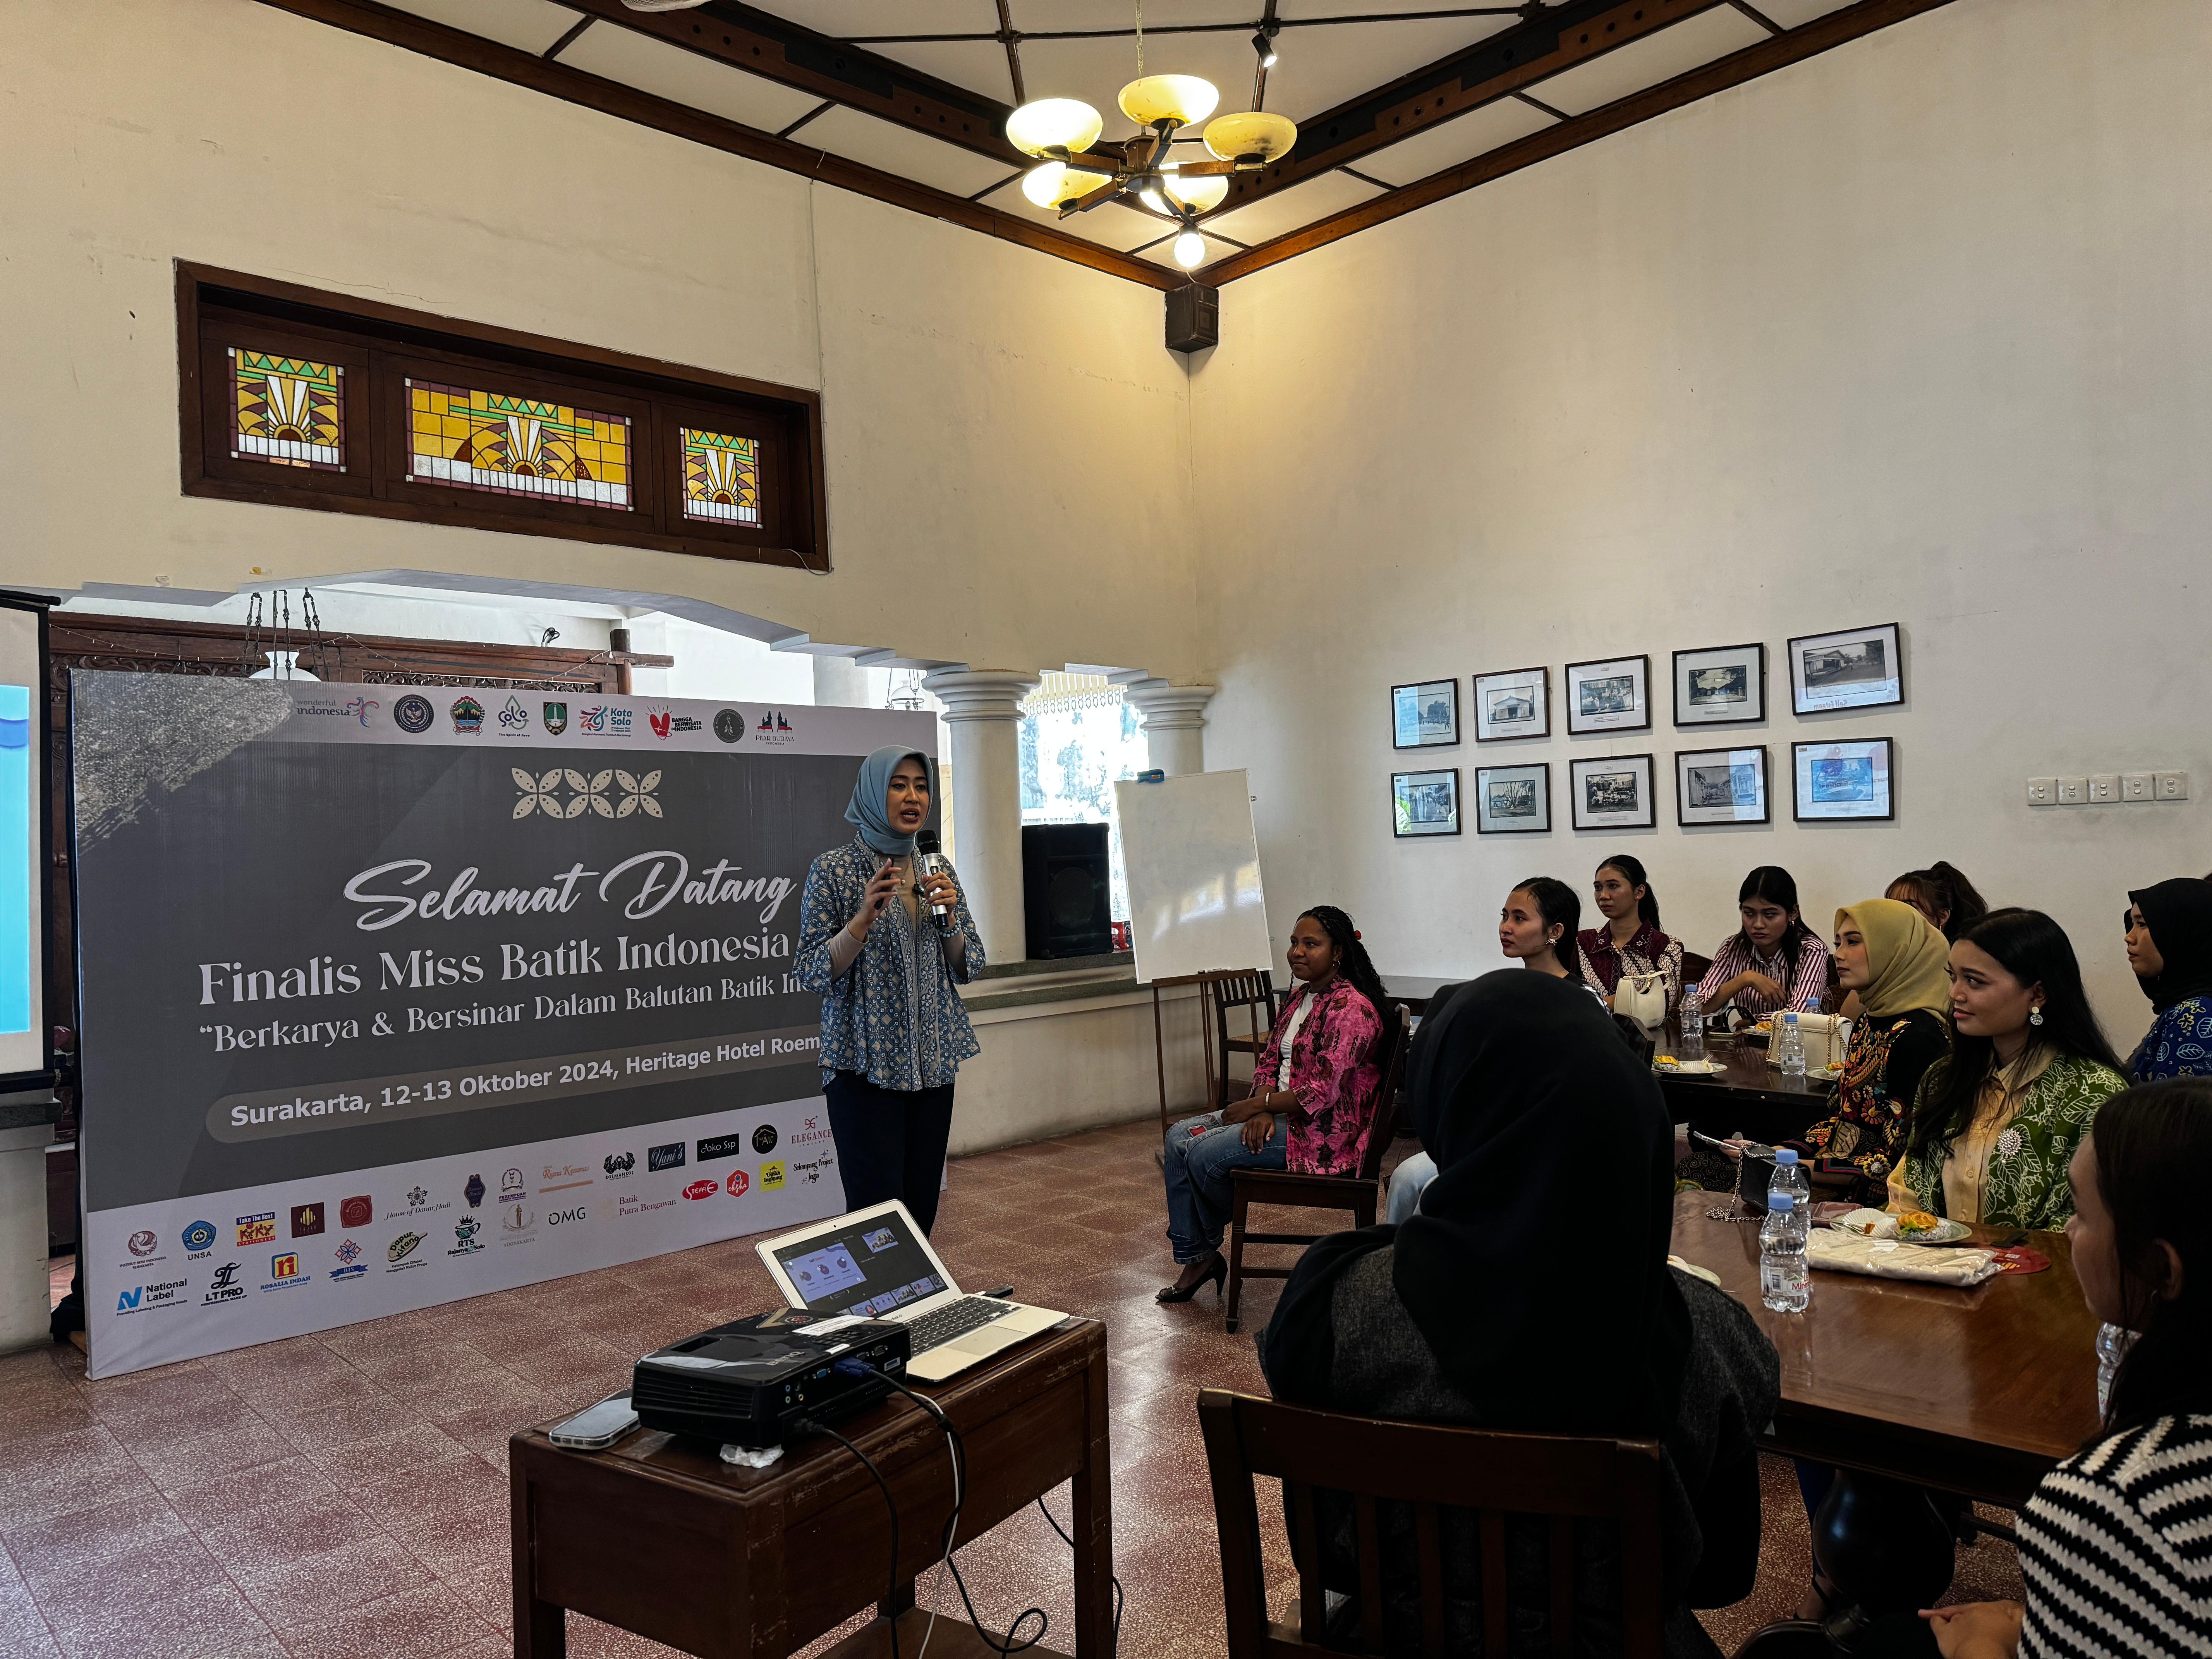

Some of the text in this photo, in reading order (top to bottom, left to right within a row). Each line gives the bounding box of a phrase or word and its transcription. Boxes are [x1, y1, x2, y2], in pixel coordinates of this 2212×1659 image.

[297, 706, 350, 716] indonesia
[610, 708, 632, 717] Kota
[611, 716, 631, 726] Solo
[343, 850, 798, 931] Selamat Datang
[198, 927, 790, 1005] Finalis Miss Batik Indonesia
[371, 1012, 395, 1036] &
[407, 1002, 525, 1033] Bersinar
[534, 993, 617, 1020] Dalam
[625, 984, 713, 1010] Balutan
[721, 974, 775, 1000] Batik
[231, 1094, 372, 1127] Surakarta,
[380, 1080, 452, 1107] 12-13
[459, 1070, 553, 1097] Oktober
[559, 1060, 619, 1084] 2024,
[626, 1051, 711, 1075] Heritage
[716, 1040, 765, 1062] Hotel
[791, 1129, 833, 1144] ELEGANCE
[701, 1141, 736, 1154] Joko Ssp
[651, 1144, 684, 1171] Yani's
[793, 1158, 834, 1171] Selempang Project
[499, 1192, 526, 1200] PEREMPUAN
[619, 1195, 638, 1205] Batik
[384, 1212, 406, 1221] House
[407, 1207, 414, 1216] of
[433, 1202, 451, 1212] Hadi
[619, 1199, 677, 1216] Putra Bengawan
[548, 1207, 586, 1225] OMG
[390, 1231, 414, 1251] Dapur
[396, 1236, 420, 1258] Kifano
[458, 1238, 475, 1247] RTS
[504, 1238, 536, 1247] YOGYAKARTA
[187, 1251, 212, 1261] UNSA
[146, 1278, 187, 1293] National
[260, 1276, 311, 1290] ROSALIA INDAH
[146, 1290, 174, 1302] Label
